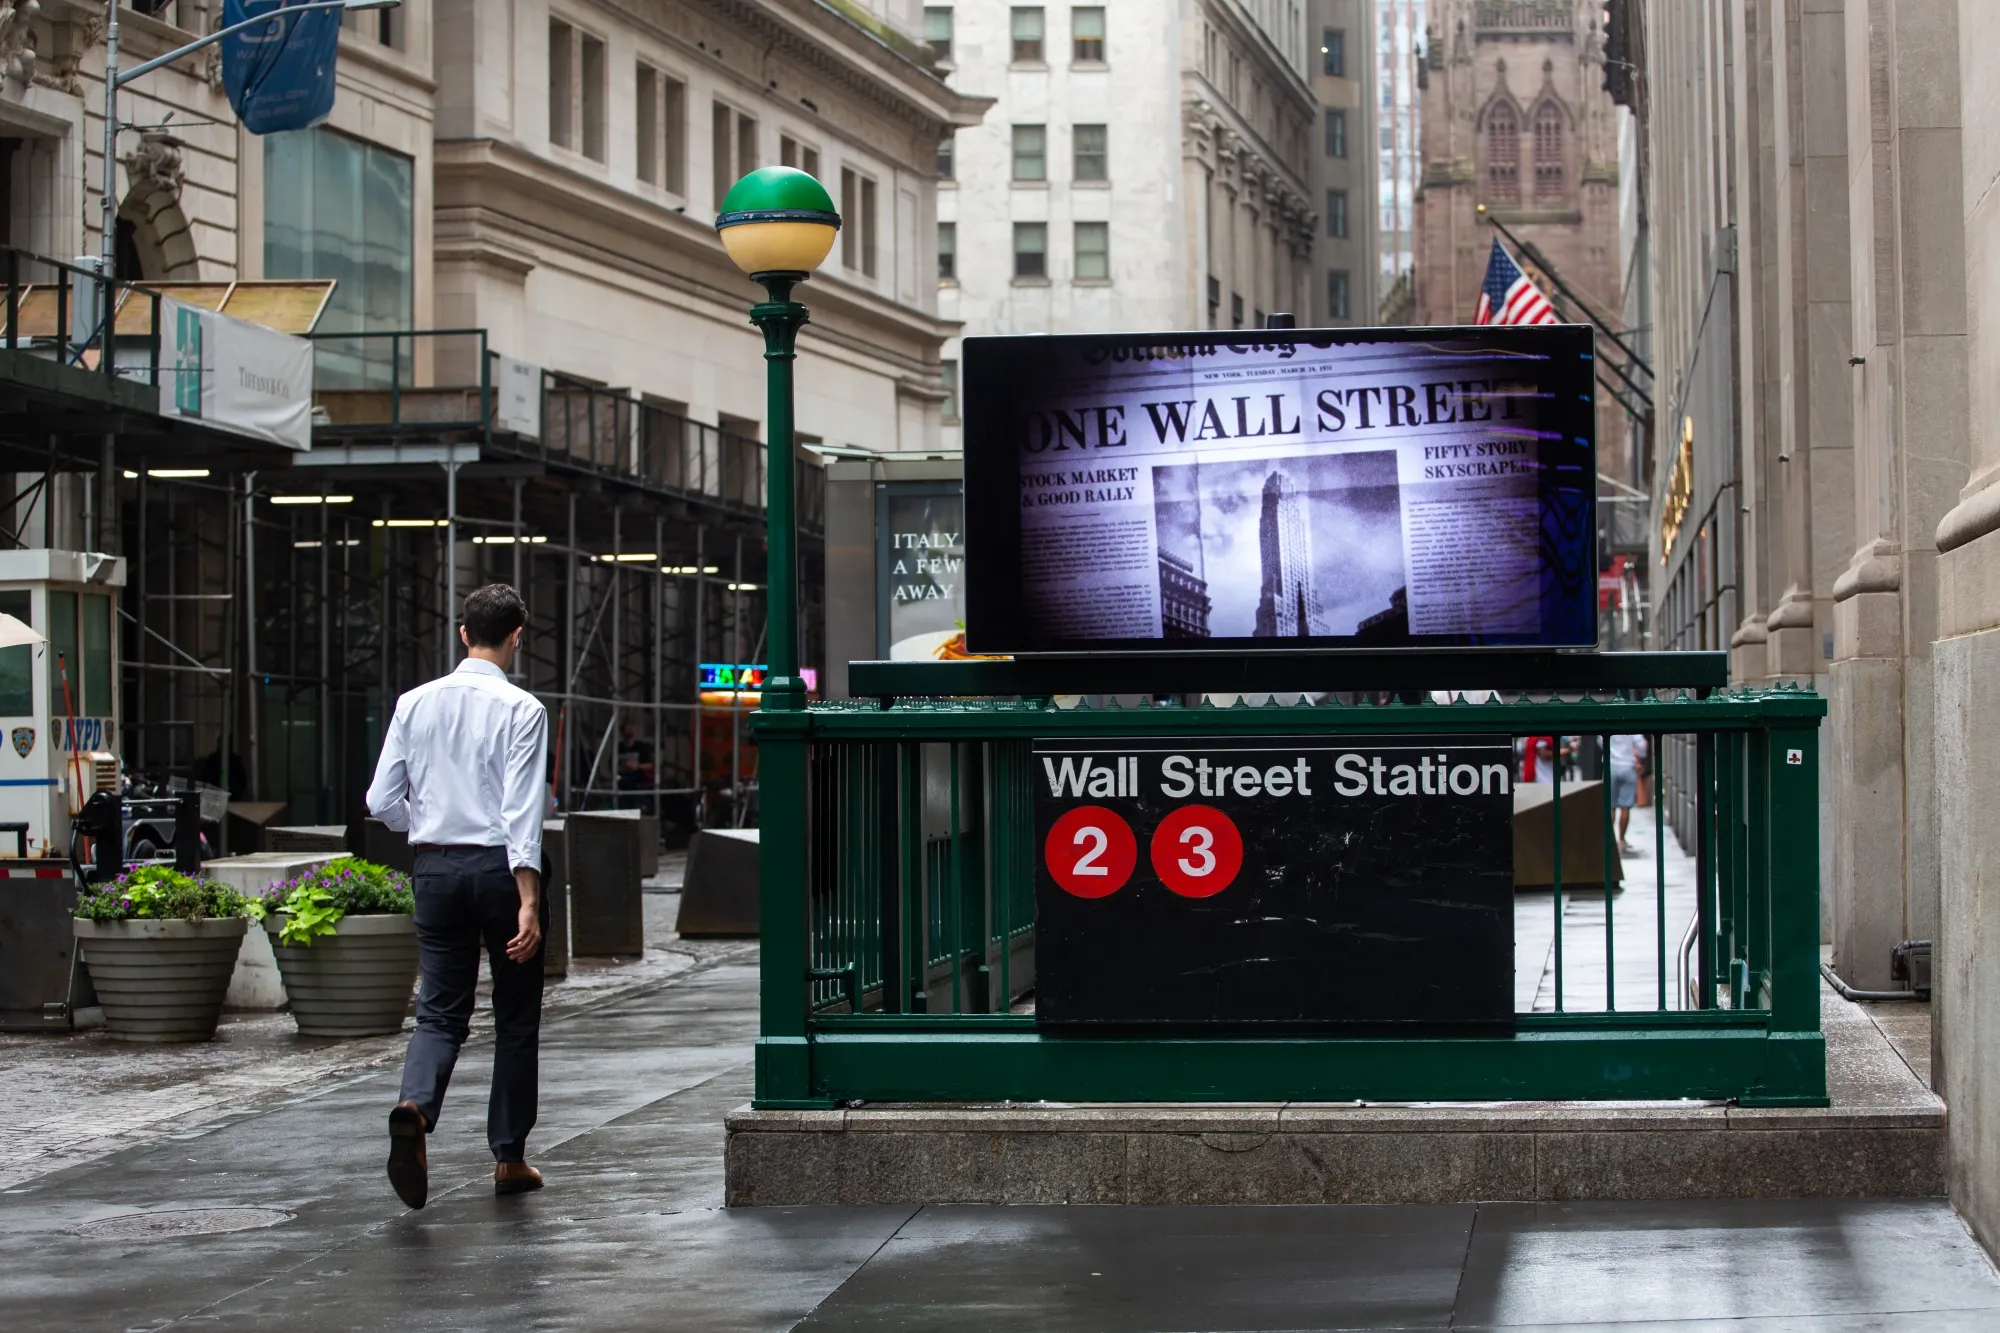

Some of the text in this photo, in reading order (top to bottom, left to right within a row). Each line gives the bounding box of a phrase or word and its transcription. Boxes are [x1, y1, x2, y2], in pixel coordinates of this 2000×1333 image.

[1280, 366, 1306, 375] MARCH
[1022, 379, 1532, 453] ONE WALL STREET
[1424, 440, 1528, 460] FIFTY STORY
[1019, 467, 1138, 489] STOCK MARKET
[1424, 460, 1531, 479] SKYSCRAPER
[1022, 486, 1135, 508] & GOOD RALLY
[893, 532, 960, 550] ITALY
[892, 558, 962, 575] A FEW
[893, 584, 954, 600] AWAY
[63, 718, 102, 751] NYPD
[1042, 753, 1509, 798] Wall Street Station
[1072, 826, 1217, 877] 2 3
